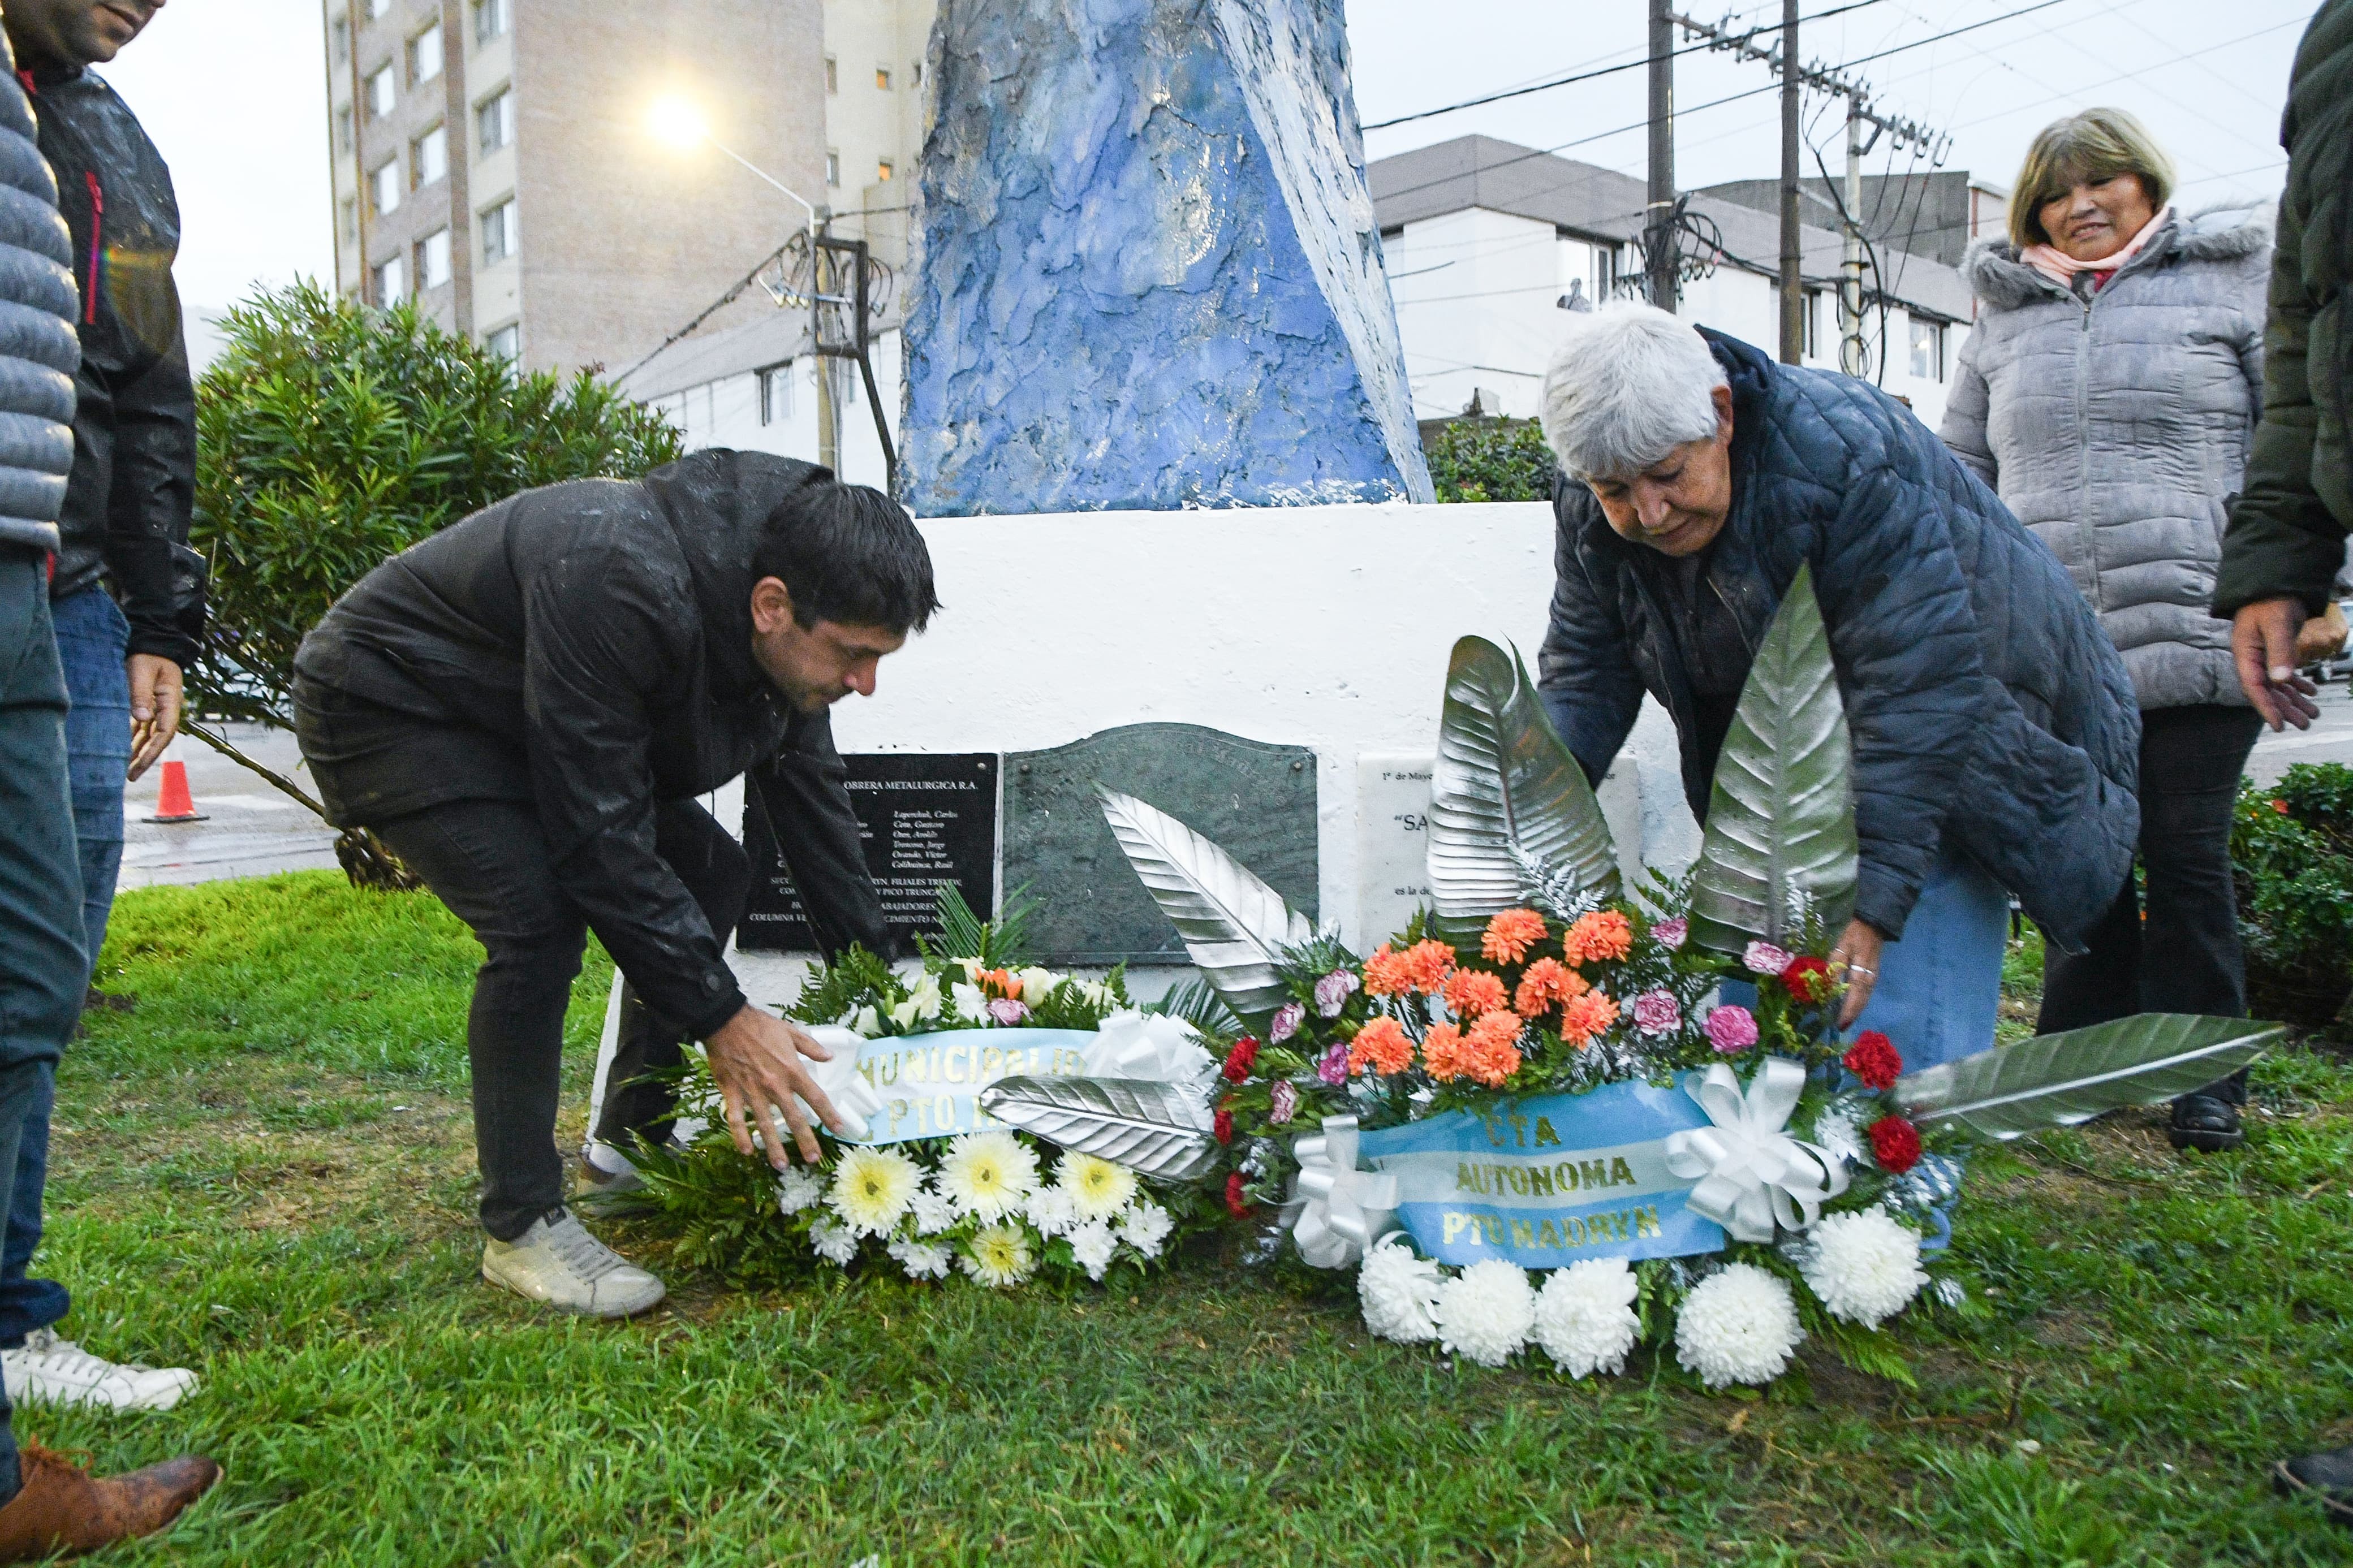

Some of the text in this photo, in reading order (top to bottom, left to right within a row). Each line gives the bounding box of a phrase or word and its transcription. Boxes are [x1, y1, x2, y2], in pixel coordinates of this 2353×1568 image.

[843, 781, 883, 790] OBRERA
[885, 781, 957, 790] METALURGICA
[1395, 772, 1406, 780] de
[1485, 1115, 1562, 1148] CTA
[1456, 1156, 1636, 1197] AUTONOMA
[1509, 1204, 1663, 1249] MADRYN
